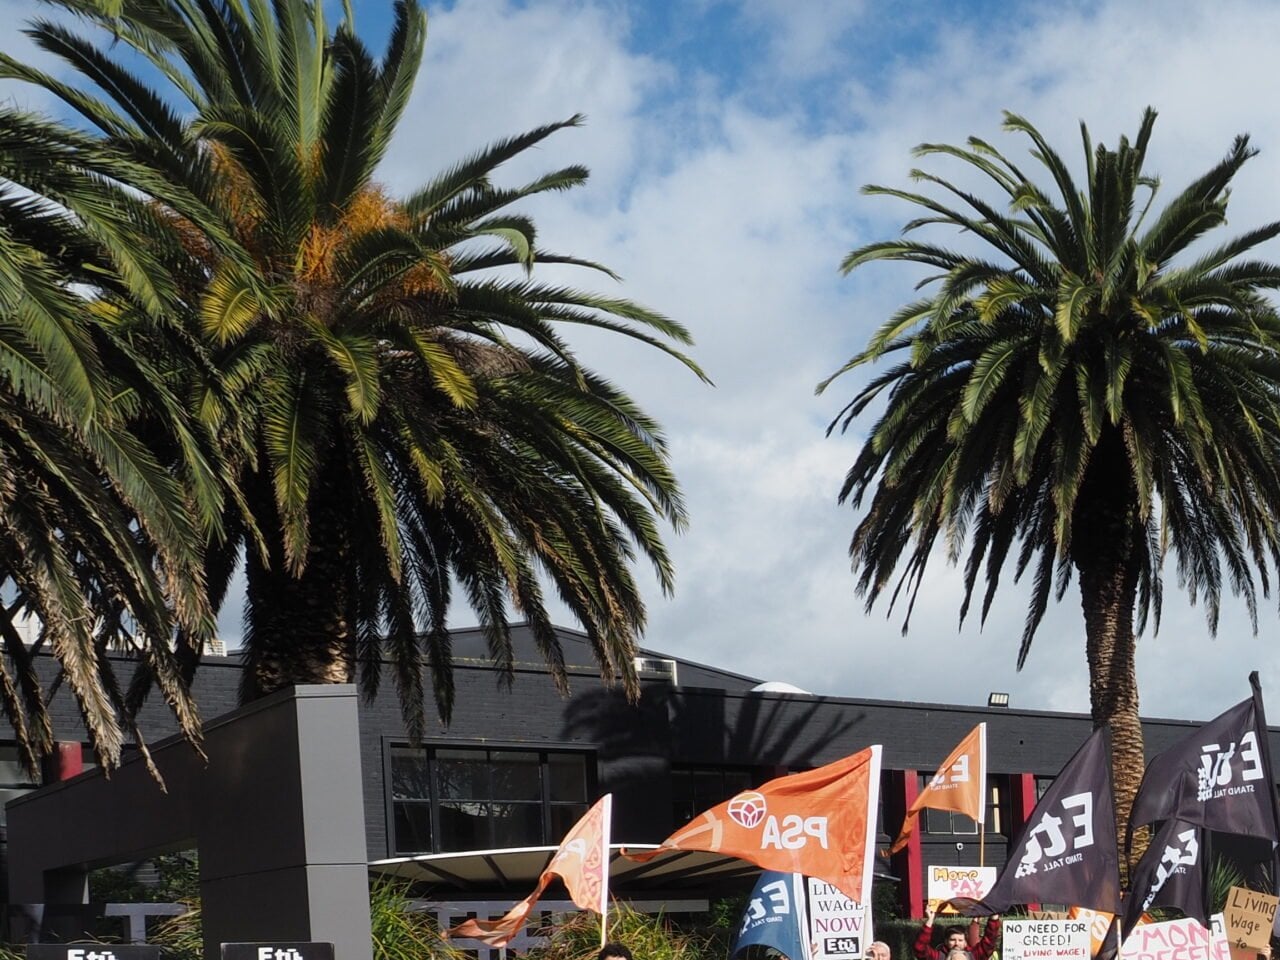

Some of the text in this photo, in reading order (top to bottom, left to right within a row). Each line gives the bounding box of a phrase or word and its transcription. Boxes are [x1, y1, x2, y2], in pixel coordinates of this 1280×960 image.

[934, 867, 978, 882] More
[818, 900, 863, 912] WAGE
[1231, 888, 1278, 923] Living
[815, 917, 863, 932] NOW
[1006, 923, 1087, 933] NO NEED FOR
[1023, 935, 1071, 946] GREED!
[1023, 949, 1052, 957] LIVING
